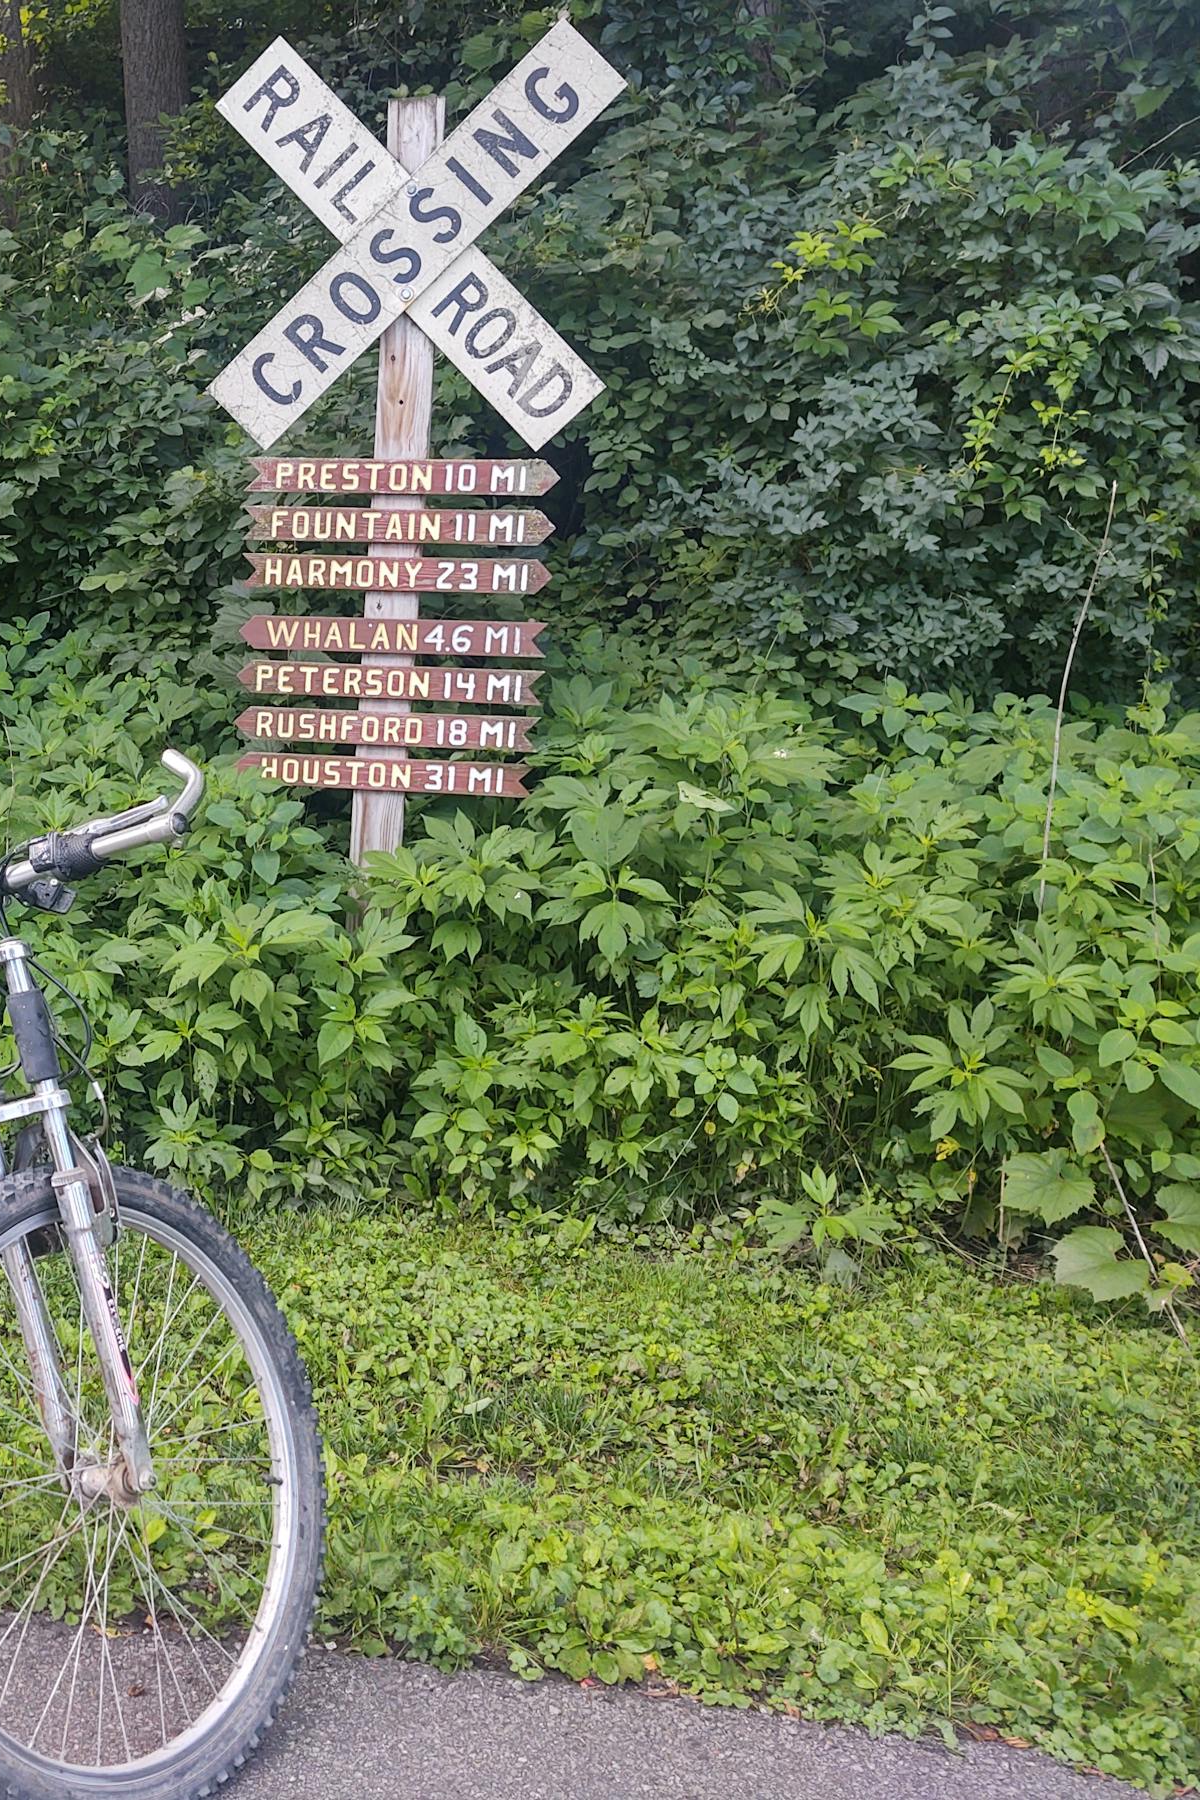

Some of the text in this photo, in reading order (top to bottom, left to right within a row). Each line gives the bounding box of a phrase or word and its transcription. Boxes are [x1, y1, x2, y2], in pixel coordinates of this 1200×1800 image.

[242, 64, 573, 418] RAIL ROAD
[251, 66, 580, 405] CROSSING
[275, 462, 527, 492] PRESTON 10 MI
[271, 510, 524, 543] FOUNTAIN 11 MI
[264, 558, 528, 591] HARMONY 23 MI
[265, 620, 521, 655] WHALAN 4.6 MI
[255, 664, 522, 703] PETERSON 14 MI
[255, 711, 516, 749] RUSHFORD 18 MI
[260, 757, 504, 794] HOUSTON 31 MI
